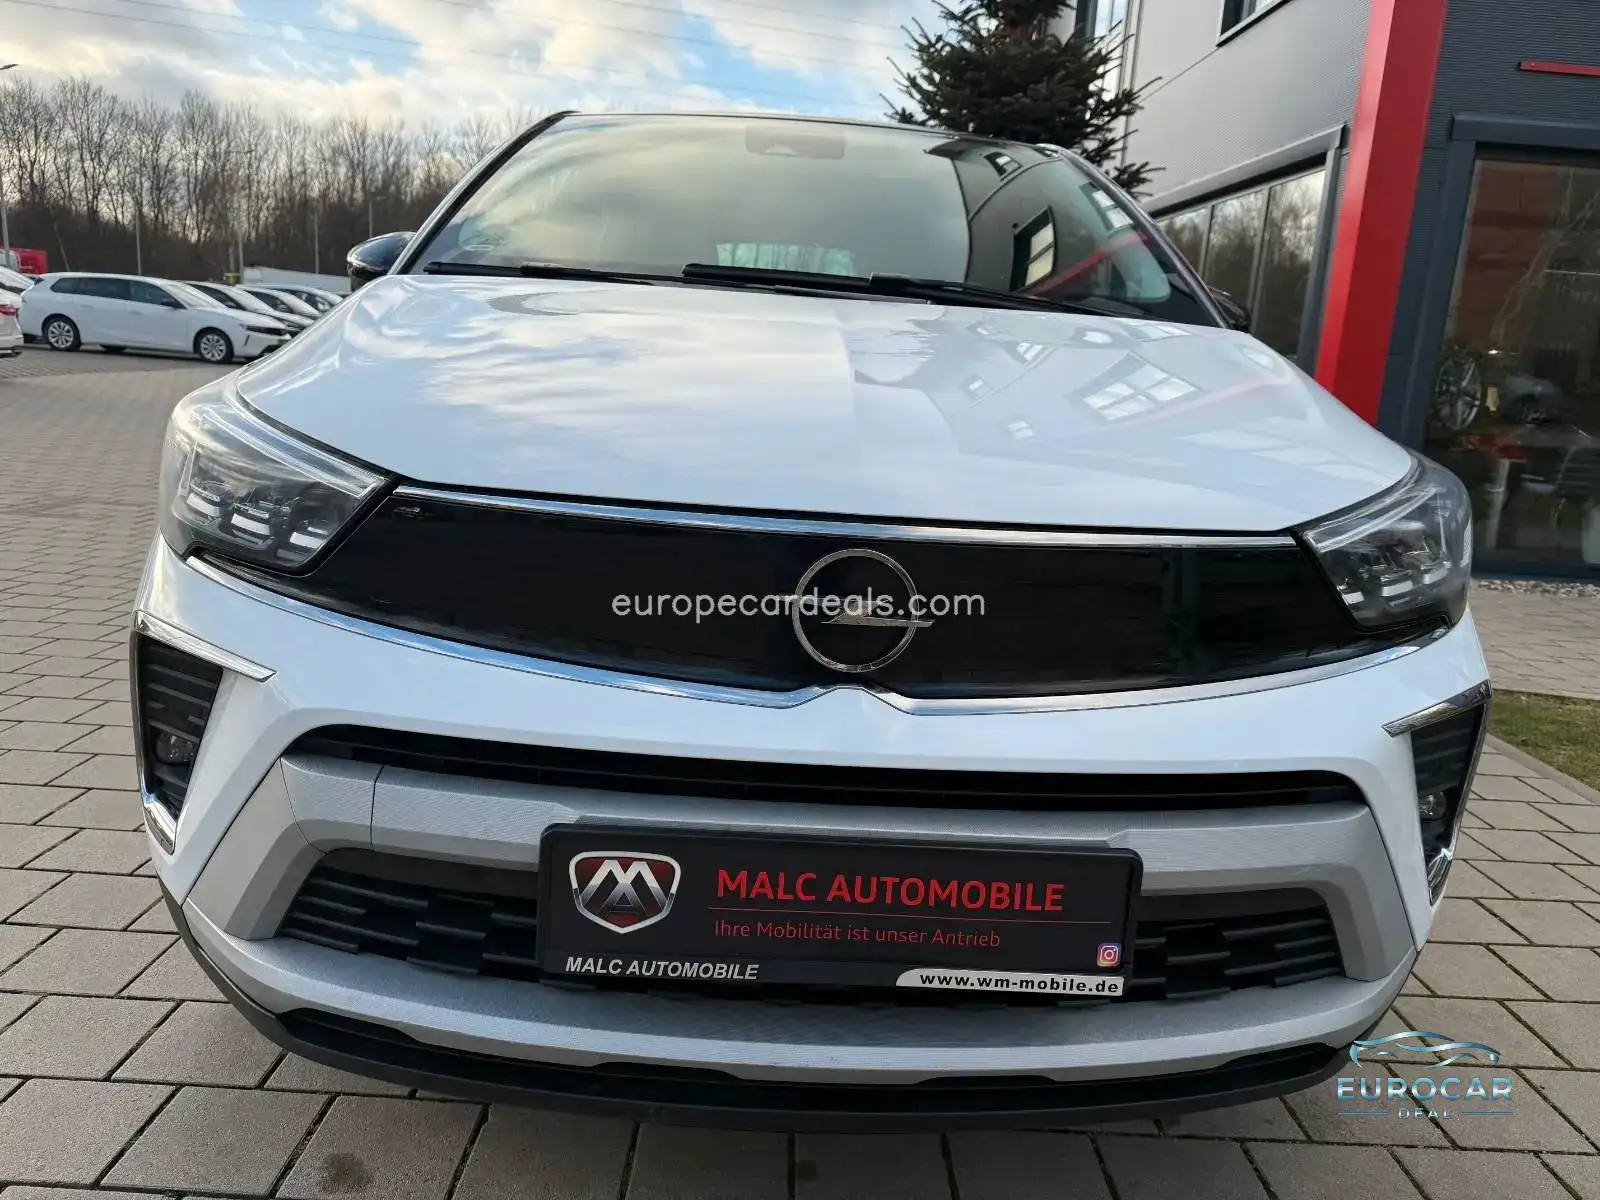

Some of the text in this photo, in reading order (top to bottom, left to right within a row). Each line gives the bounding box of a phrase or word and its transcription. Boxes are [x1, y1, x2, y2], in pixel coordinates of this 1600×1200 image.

[716, 868, 1064, 912] MALC AUTOMOBILE
[715, 919, 1001, 948] Ihre Mobilität ist unser Antrieb
[565, 956, 759, 981] MALC AUTOMOBILE
[919, 971, 1119, 994] www.wm-mobile.de
